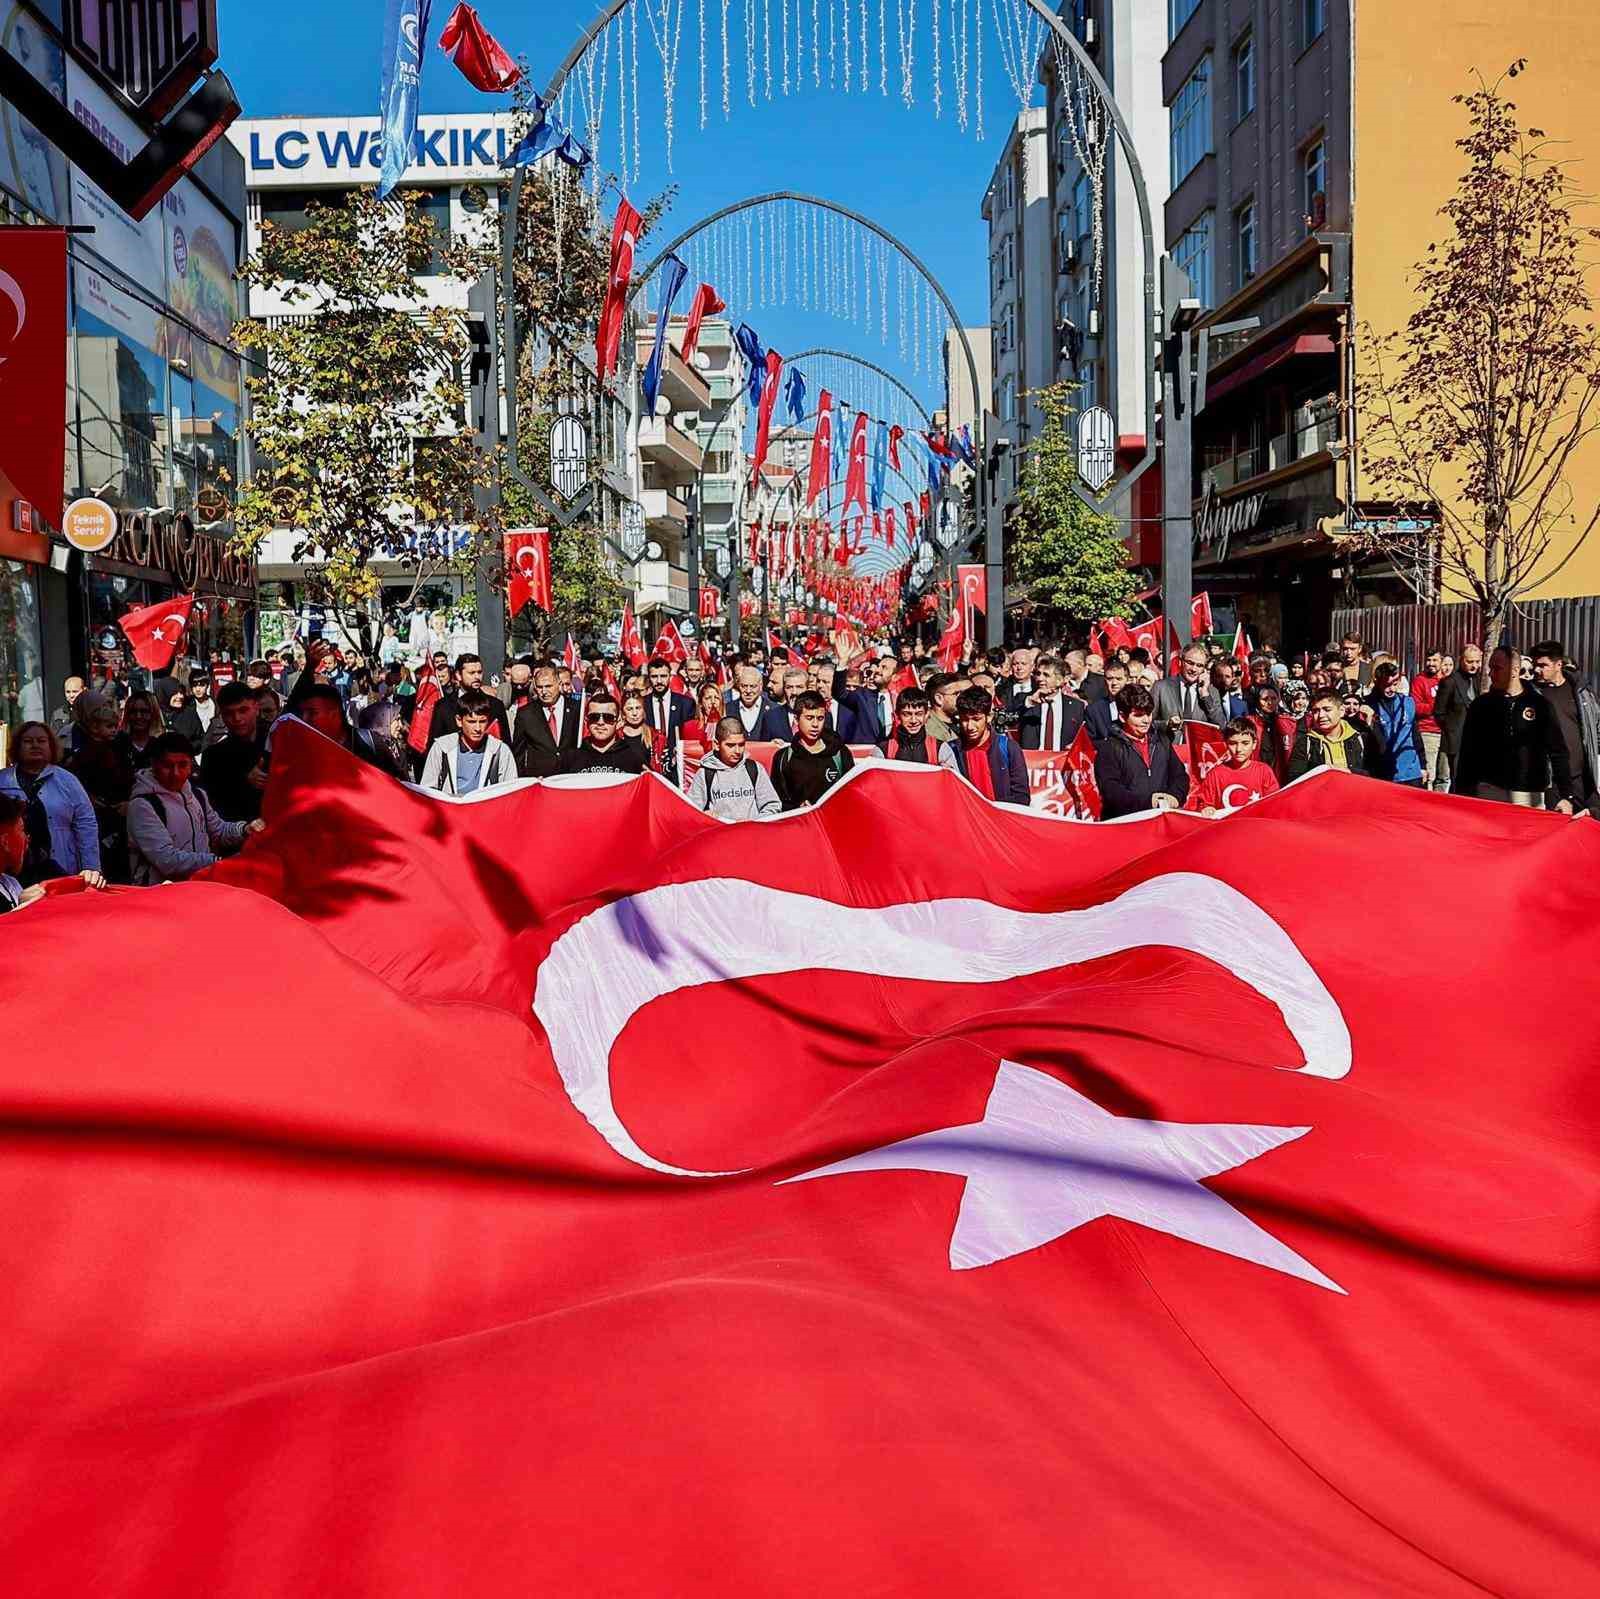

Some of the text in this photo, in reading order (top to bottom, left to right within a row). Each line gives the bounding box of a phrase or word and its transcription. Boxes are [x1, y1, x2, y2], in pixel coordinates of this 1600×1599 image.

[250, 128, 507, 169] LC WaKIKI
[73, 513, 105, 524] Teknik
[73, 526, 105, 536] Servis
